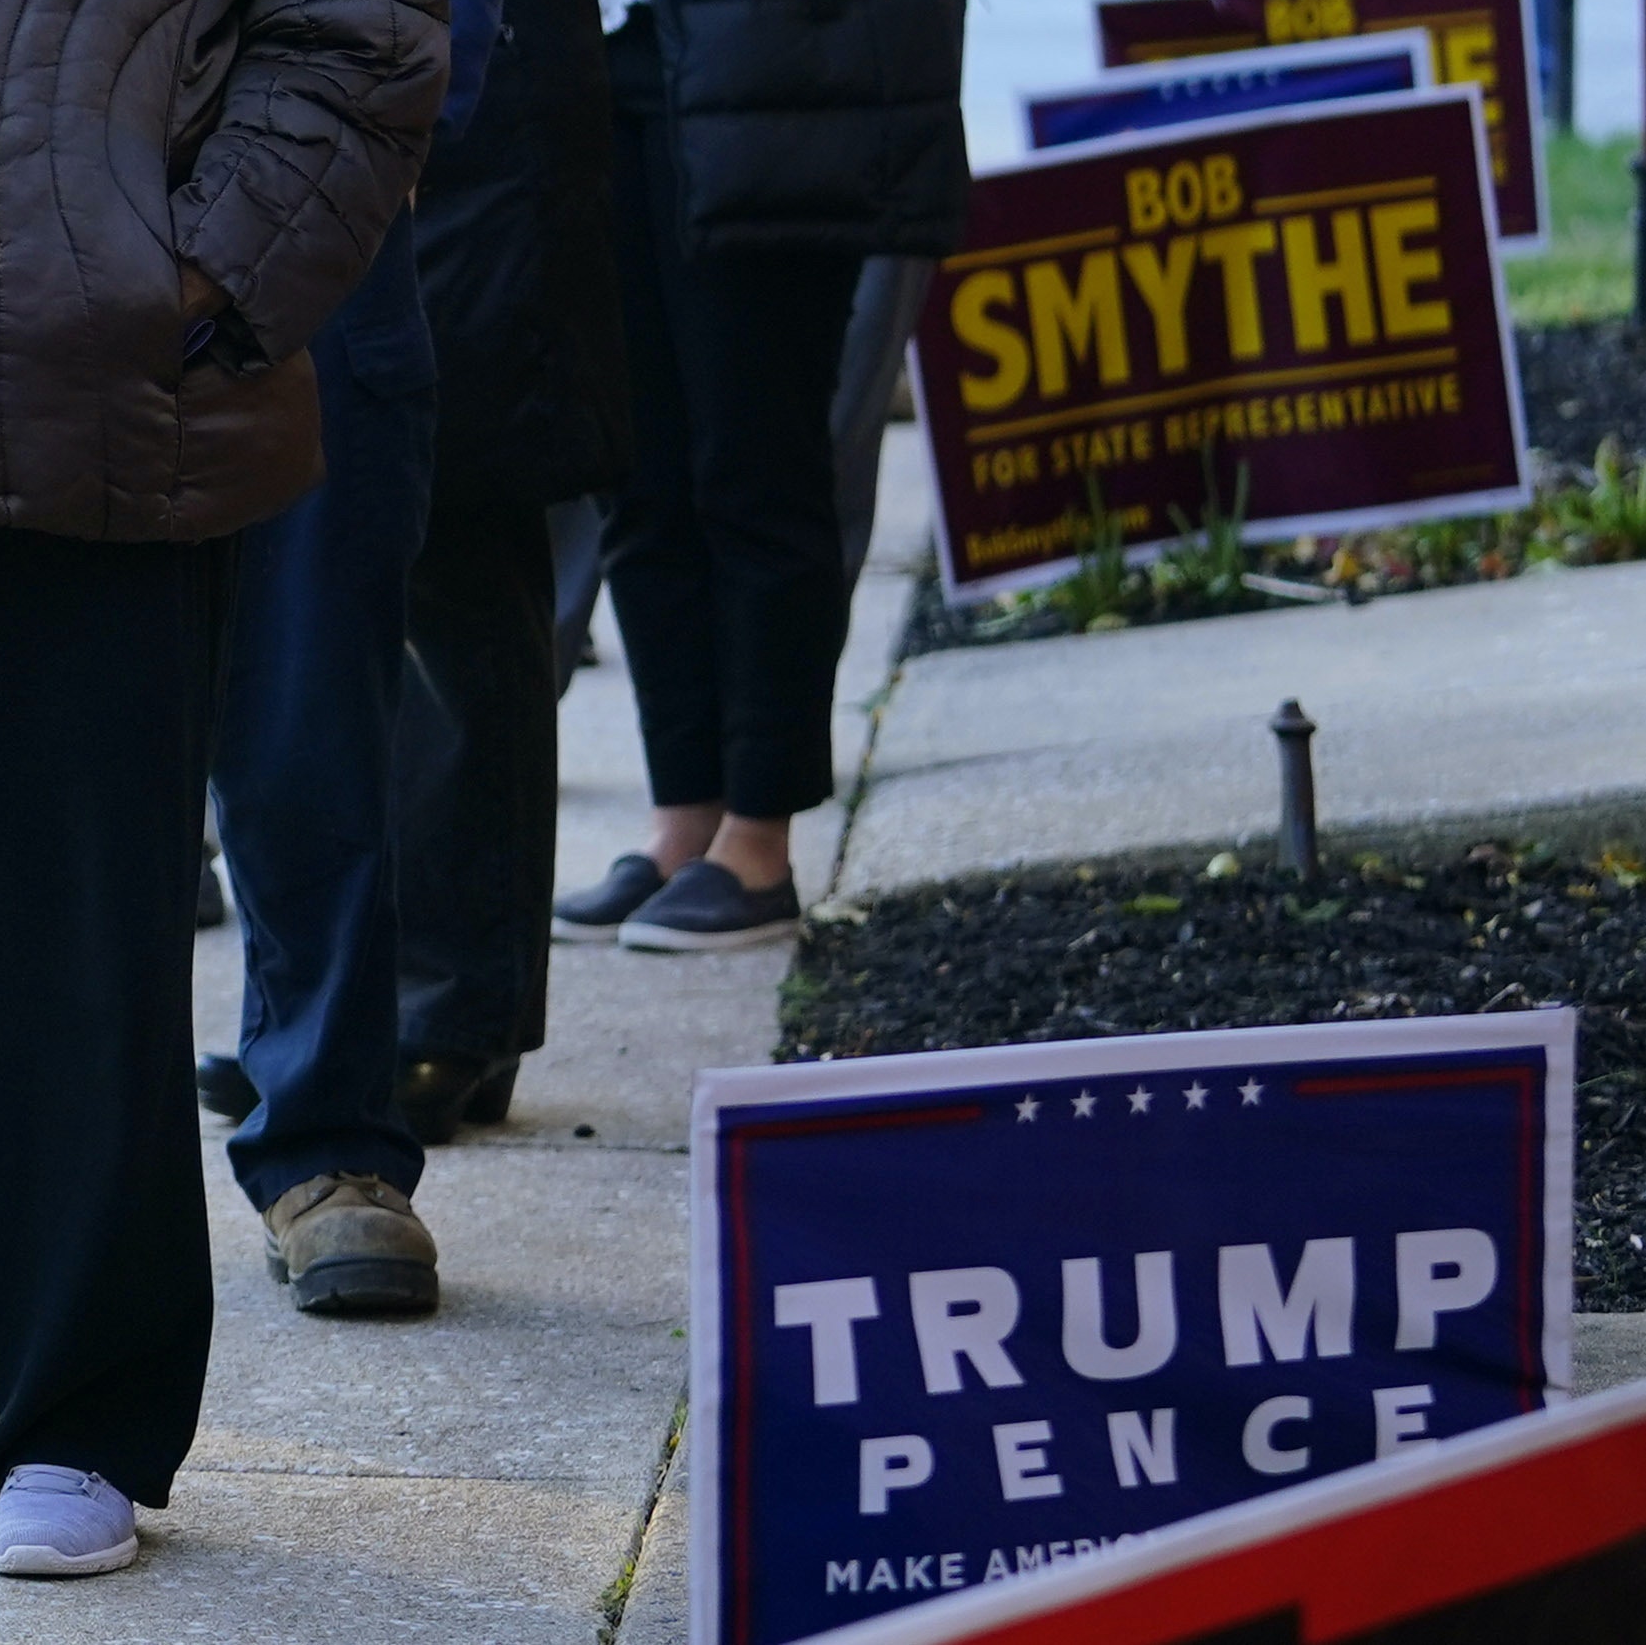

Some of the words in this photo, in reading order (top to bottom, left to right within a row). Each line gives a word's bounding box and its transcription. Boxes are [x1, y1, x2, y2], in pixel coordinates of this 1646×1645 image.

[1124, 153, 1245, 236] BOB
[949, 198, 1453, 413] SMYTHE
[972, 444, 1039, 493] FOR
[1050, 420, 1154, 476] STATE
[1164, 372, 1462, 452] REPRESENTATIVE
[773, 1228, 1500, 1408] TRUMP
[858, 1384, 1441, 1516] PENCE
[824, 1552, 966, 1595] MAKE
